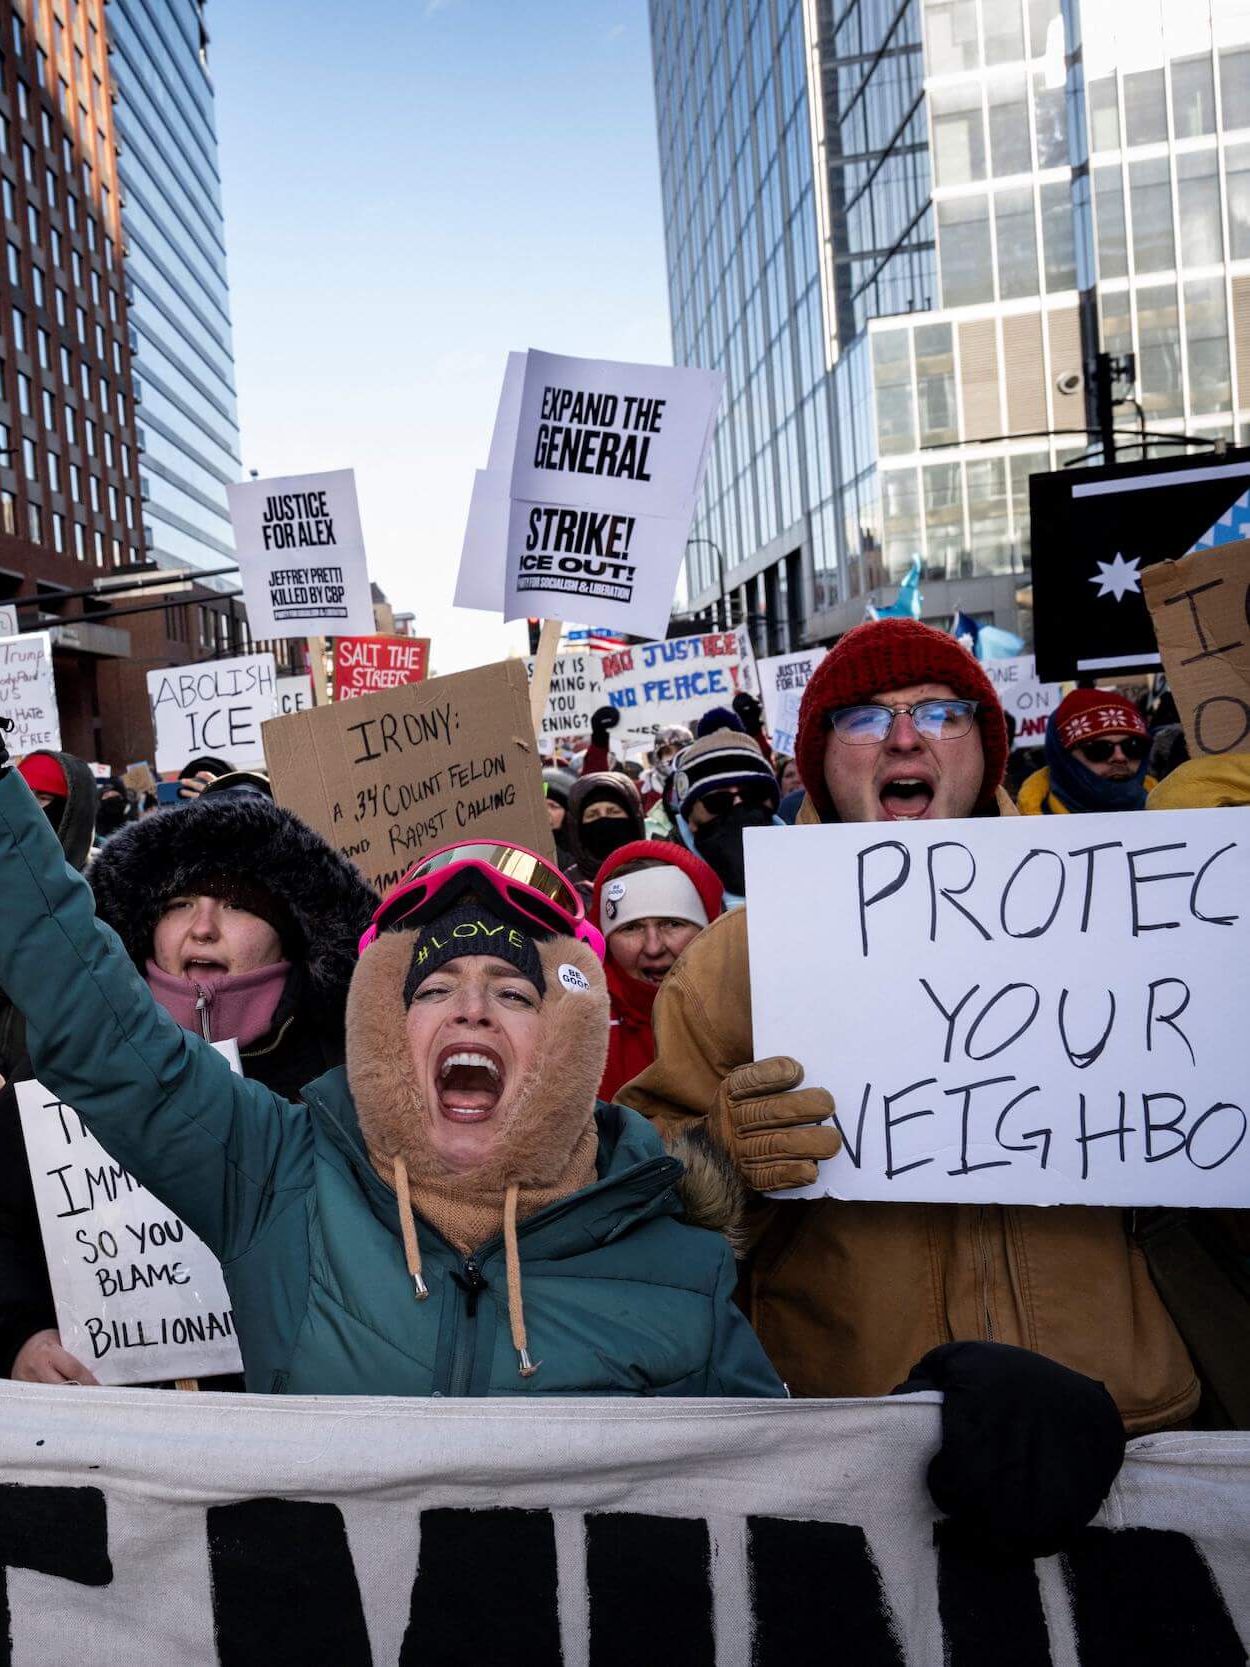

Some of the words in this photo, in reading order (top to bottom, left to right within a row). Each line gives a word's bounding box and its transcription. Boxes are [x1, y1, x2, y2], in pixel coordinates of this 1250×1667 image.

[541, 387, 618, 428] EXPAND
[622, 396, 666, 433] THE
[534, 424, 652, 482] GENERAL
[263, 491, 329, 522] JUSTICE
[262, 523, 296, 551] FOR
[300, 519, 336, 547] ALEX
[526, 507, 635, 560] STRIKE!
[269, 568, 310, 586] JEFFREY
[310, 567, 343, 584] PRETTI
[519, 554, 553, 572] ICE
[558, 557, 637, 582] OUT!
[270, 587, 308, 606] KILLED
[310, 587, 323, 604] BY
[0, 643, 44, 672] Trump
[339, 642, 384, 667] SALT
[388, 646, 420, 669] THE
[573, 657, 584, 673] IS
[602, 649, 633, 679] NO
[642, 632, 737, 668] JUSTICE
[776, 660, 812, 678] JUSTICE
[154, 665, 274, 710] ABOLISH
[352, 668, 410, 689] STREETS
[549, 695, 575, 712] YOU
[608, 687, 637, 708] NO
[1017, 692, 1049, 709] ON
[20, 731, 51, 748] FREE
[186, 706, 255, 752] ICE
[347, 703, 459, 764] IRONY:
[334, 803, 343, 823] A
[383, 772, 442, 817] COUNT
[448, 754, 506, 788] FELON
[389, 809, 447, 856] RAPIST
[456, 784, 516, 827] CALLING
[857, 840, 1240, 957] PROTEC
[416, 920, 525, 965] #LOVE
[562, 975, 590, 990] GOOD
[569, 969, 581, 979] BE
[919, 977, 1196, 1069] YOUR
[46, 1163, 142, 1217] IMM
[76, 1229, 118, 1264] SO
[125, 1219, 184, 1254] YOU
[95, 1262, 191, 1297] BLAME
[85, 1311, 234, 1358] BILLIONAI
